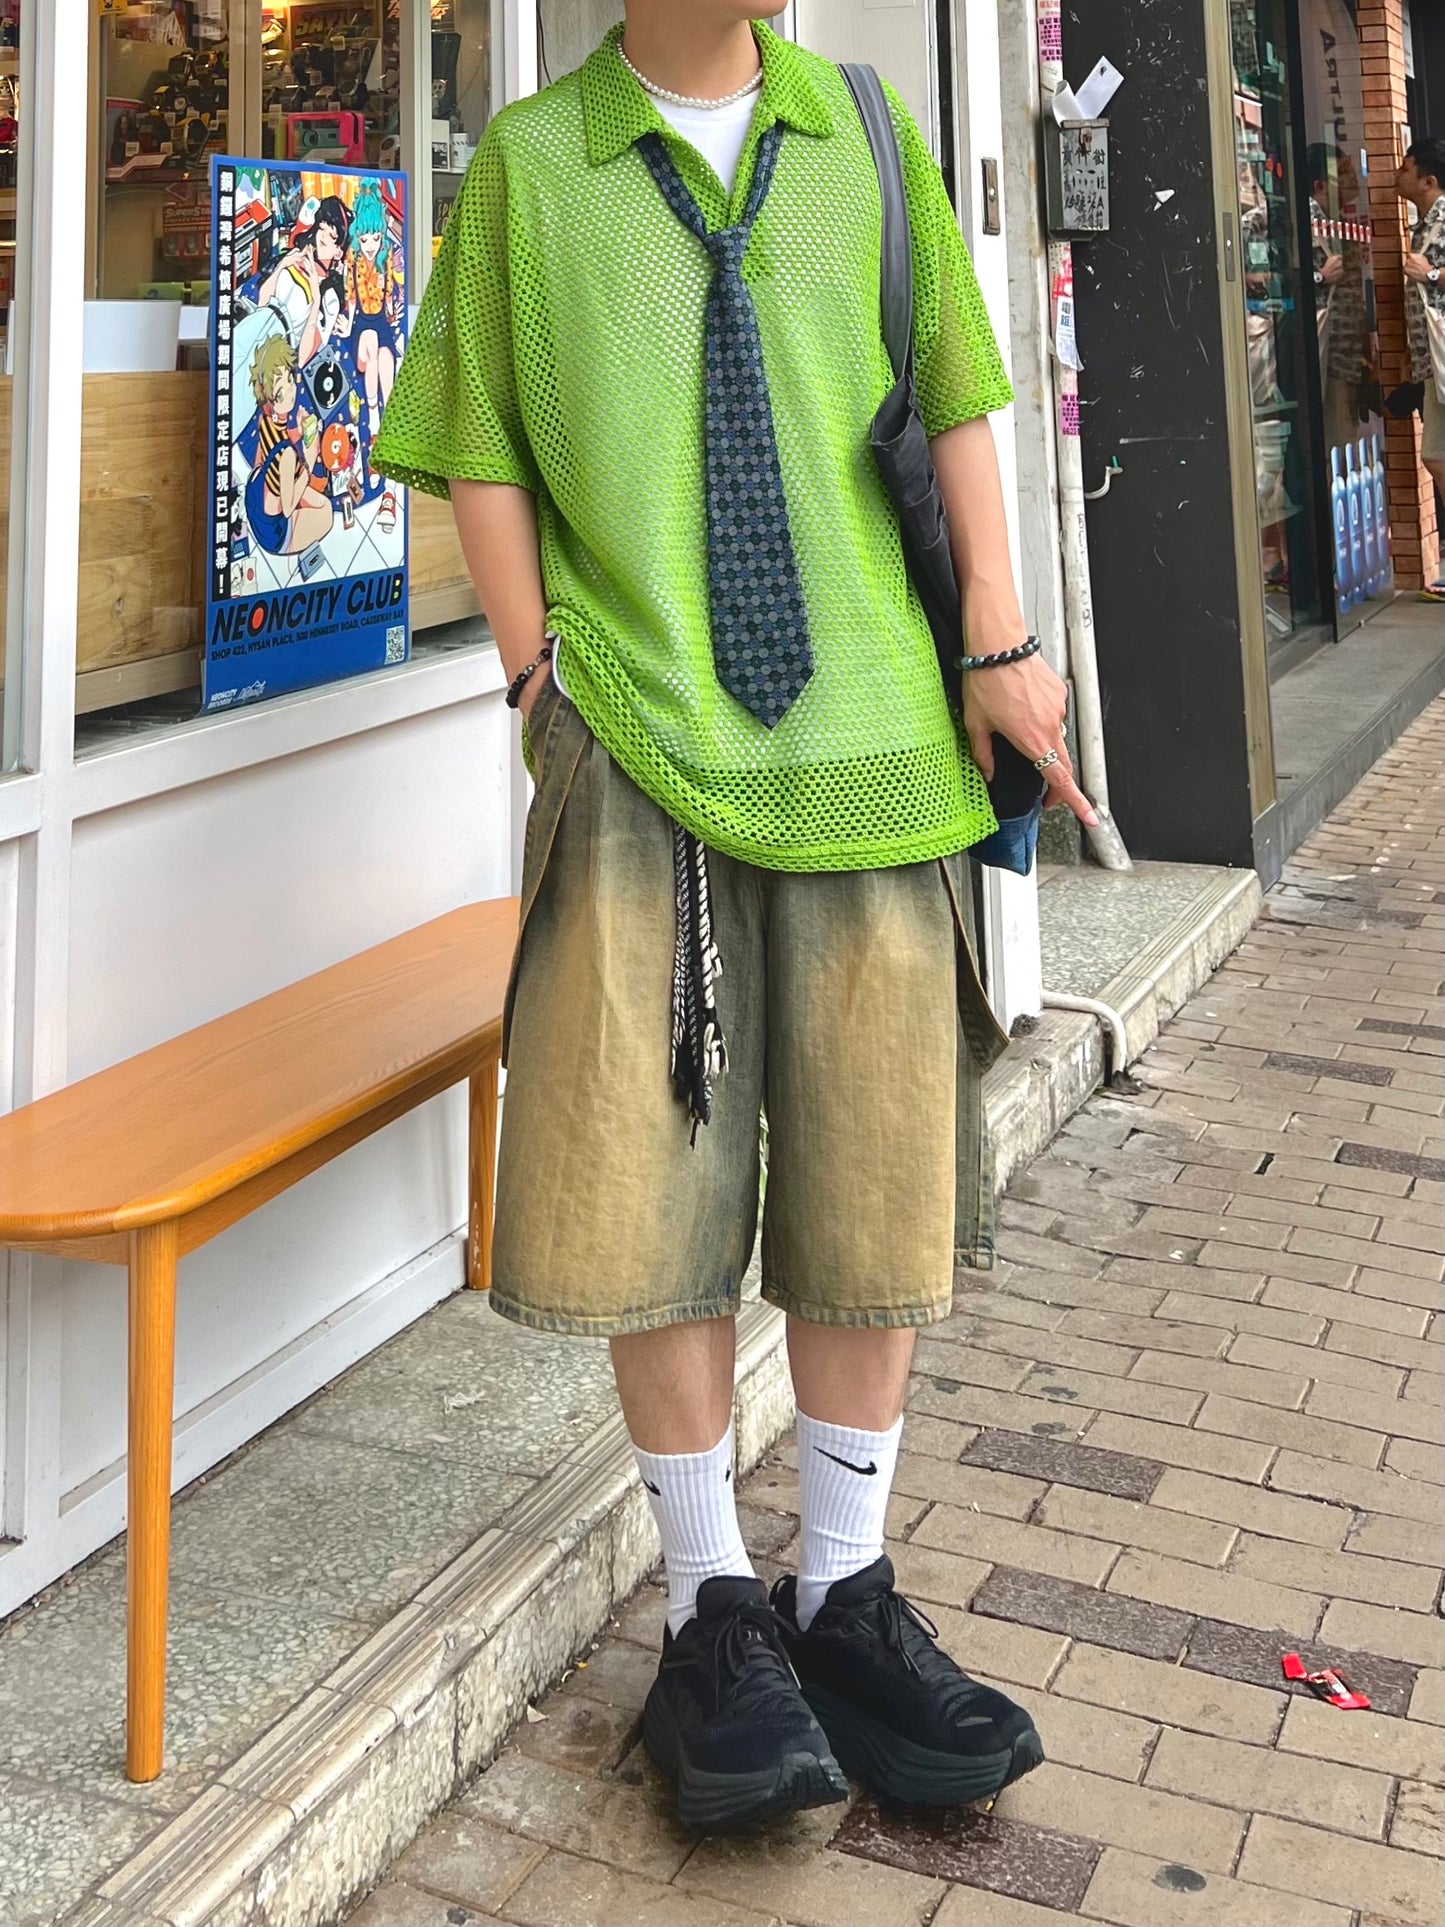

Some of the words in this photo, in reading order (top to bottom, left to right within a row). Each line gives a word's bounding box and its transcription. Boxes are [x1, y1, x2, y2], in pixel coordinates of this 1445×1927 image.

[211, 584, 343, 645] NEONCITY
[346, 573, 404, 615] CLUB
[211, 648, 232, 661] SHOP
[248, 639, 271, 653] HYSAN
